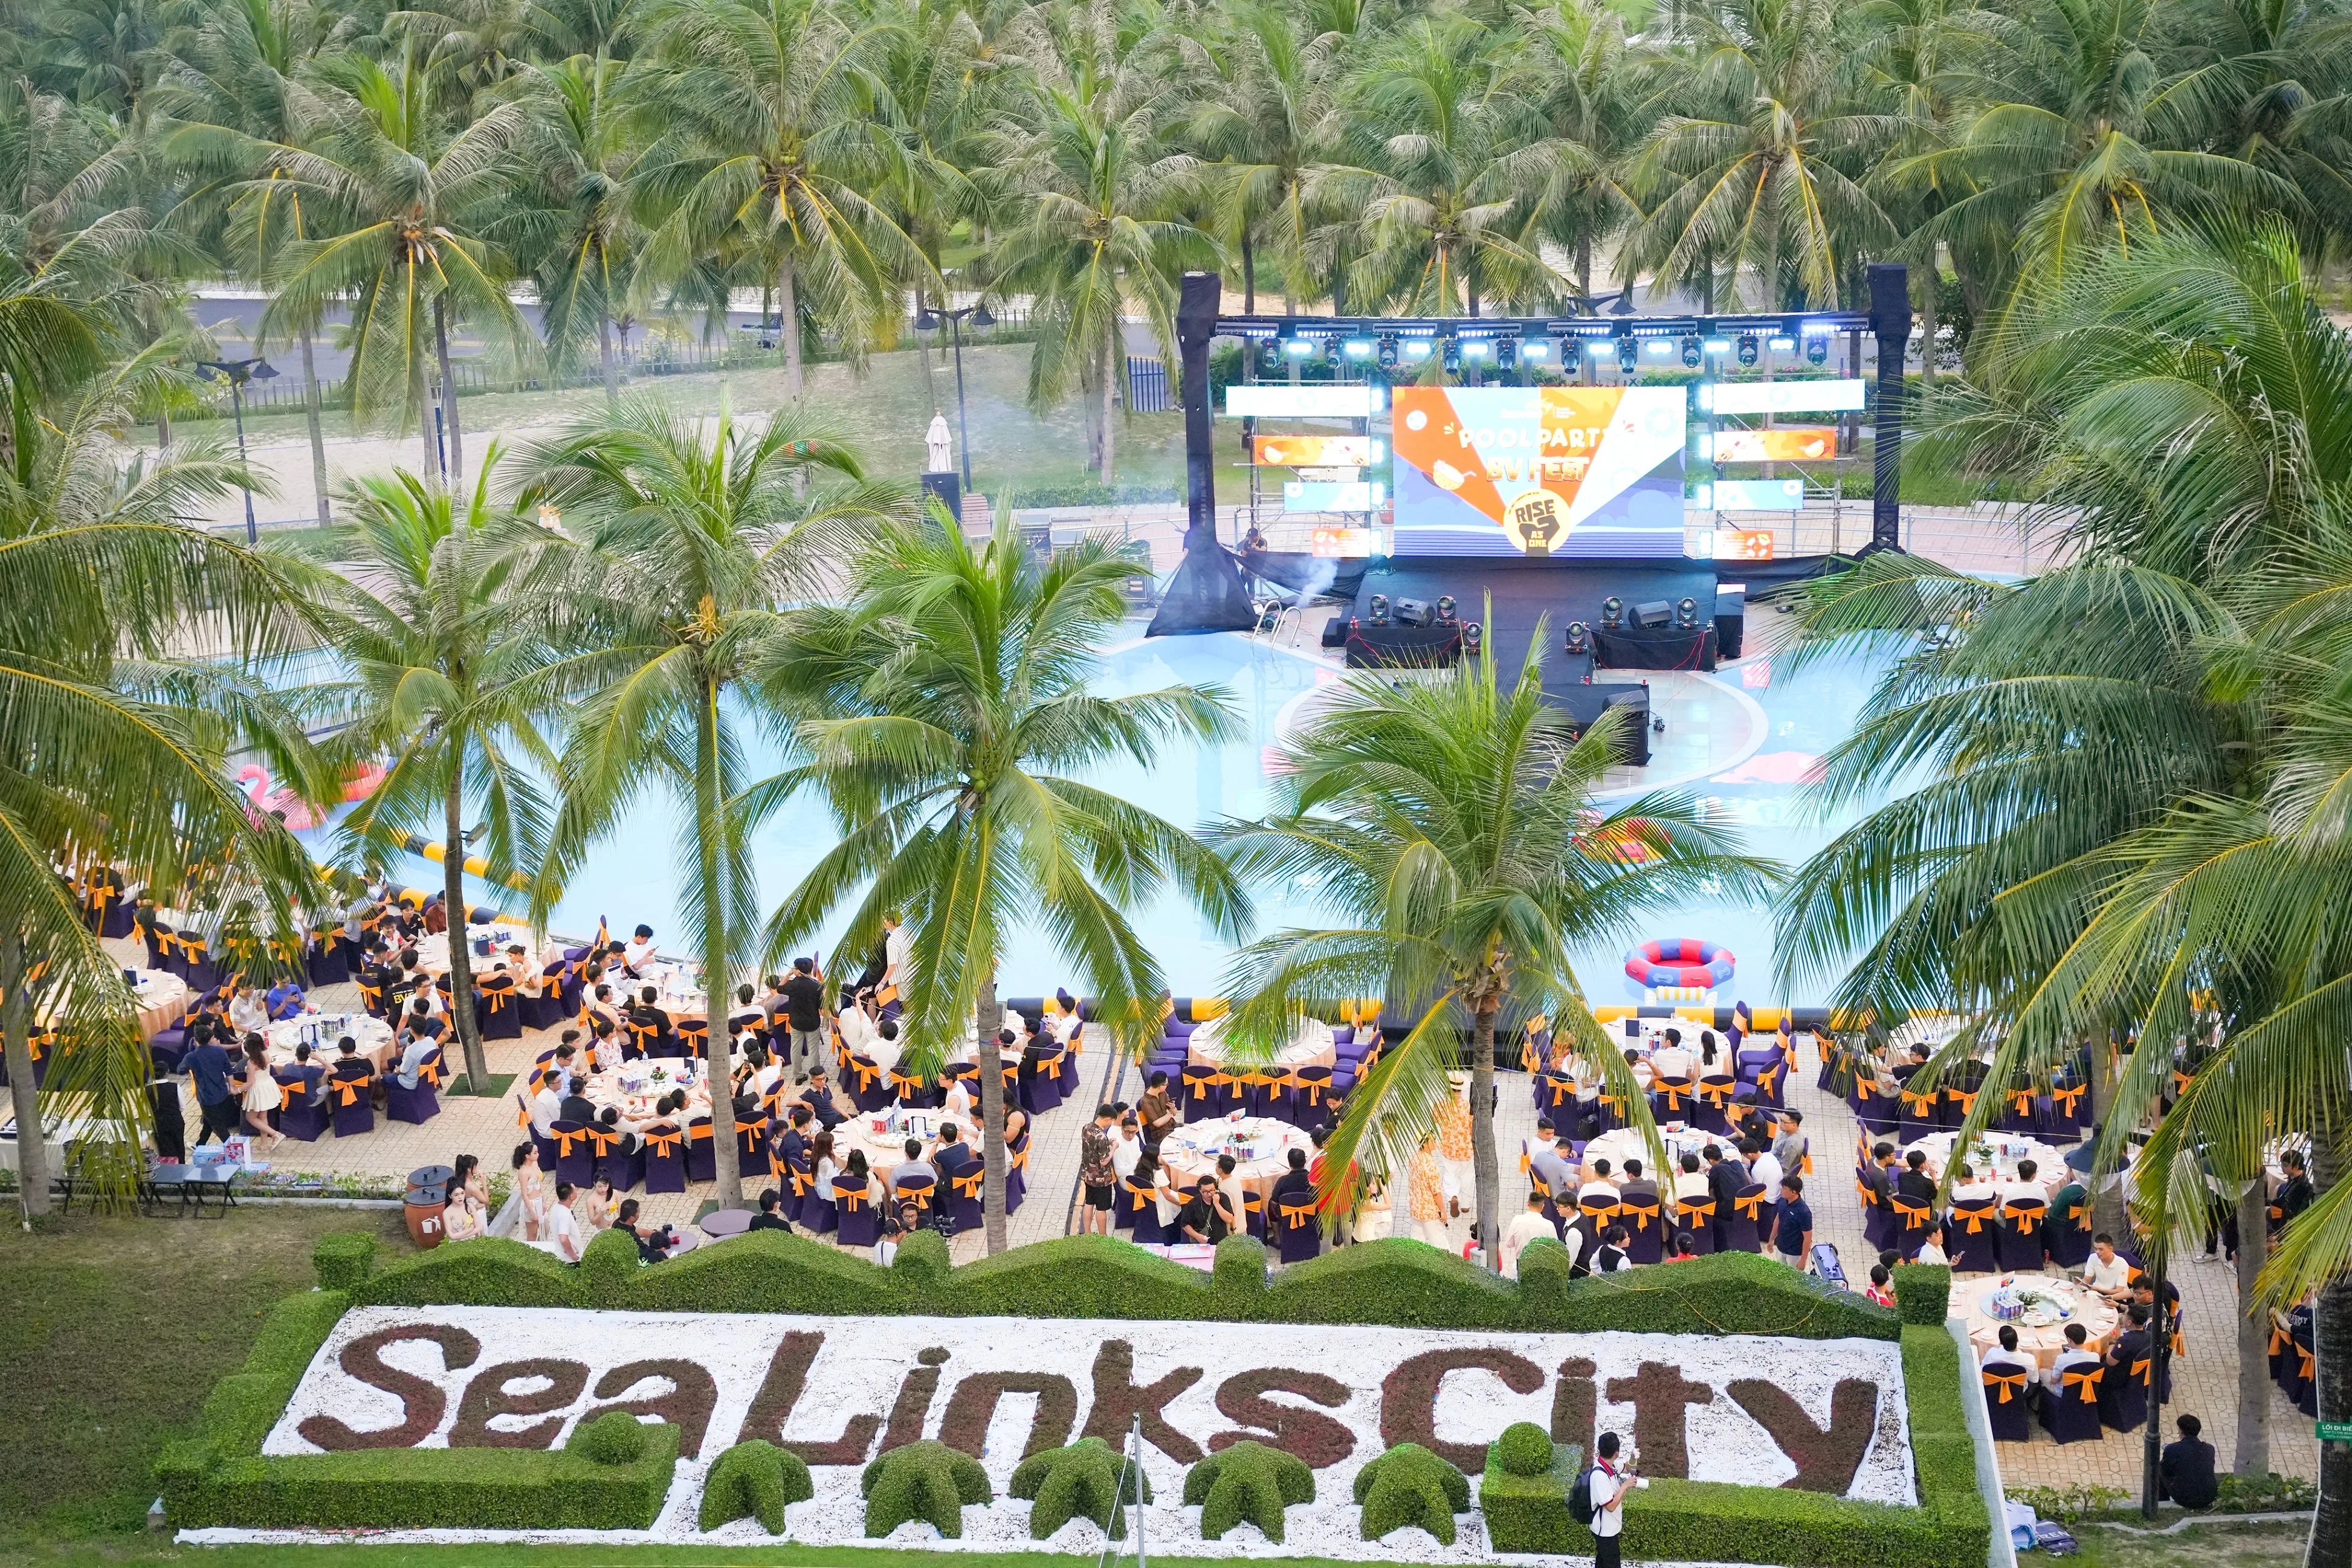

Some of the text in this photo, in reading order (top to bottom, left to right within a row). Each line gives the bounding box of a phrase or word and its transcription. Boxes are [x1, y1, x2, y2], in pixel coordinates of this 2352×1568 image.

[1458, 428, 1533, 448] POOL
[1486, 456, 1590, 482] BV FEST
[1515, 499, 1555, 523] RISE
[1528, 539, 1547, 547] ONE
[1531, 531, 1544, 539] AS
[296, 1323, 1879, 1495] Sea Links City
